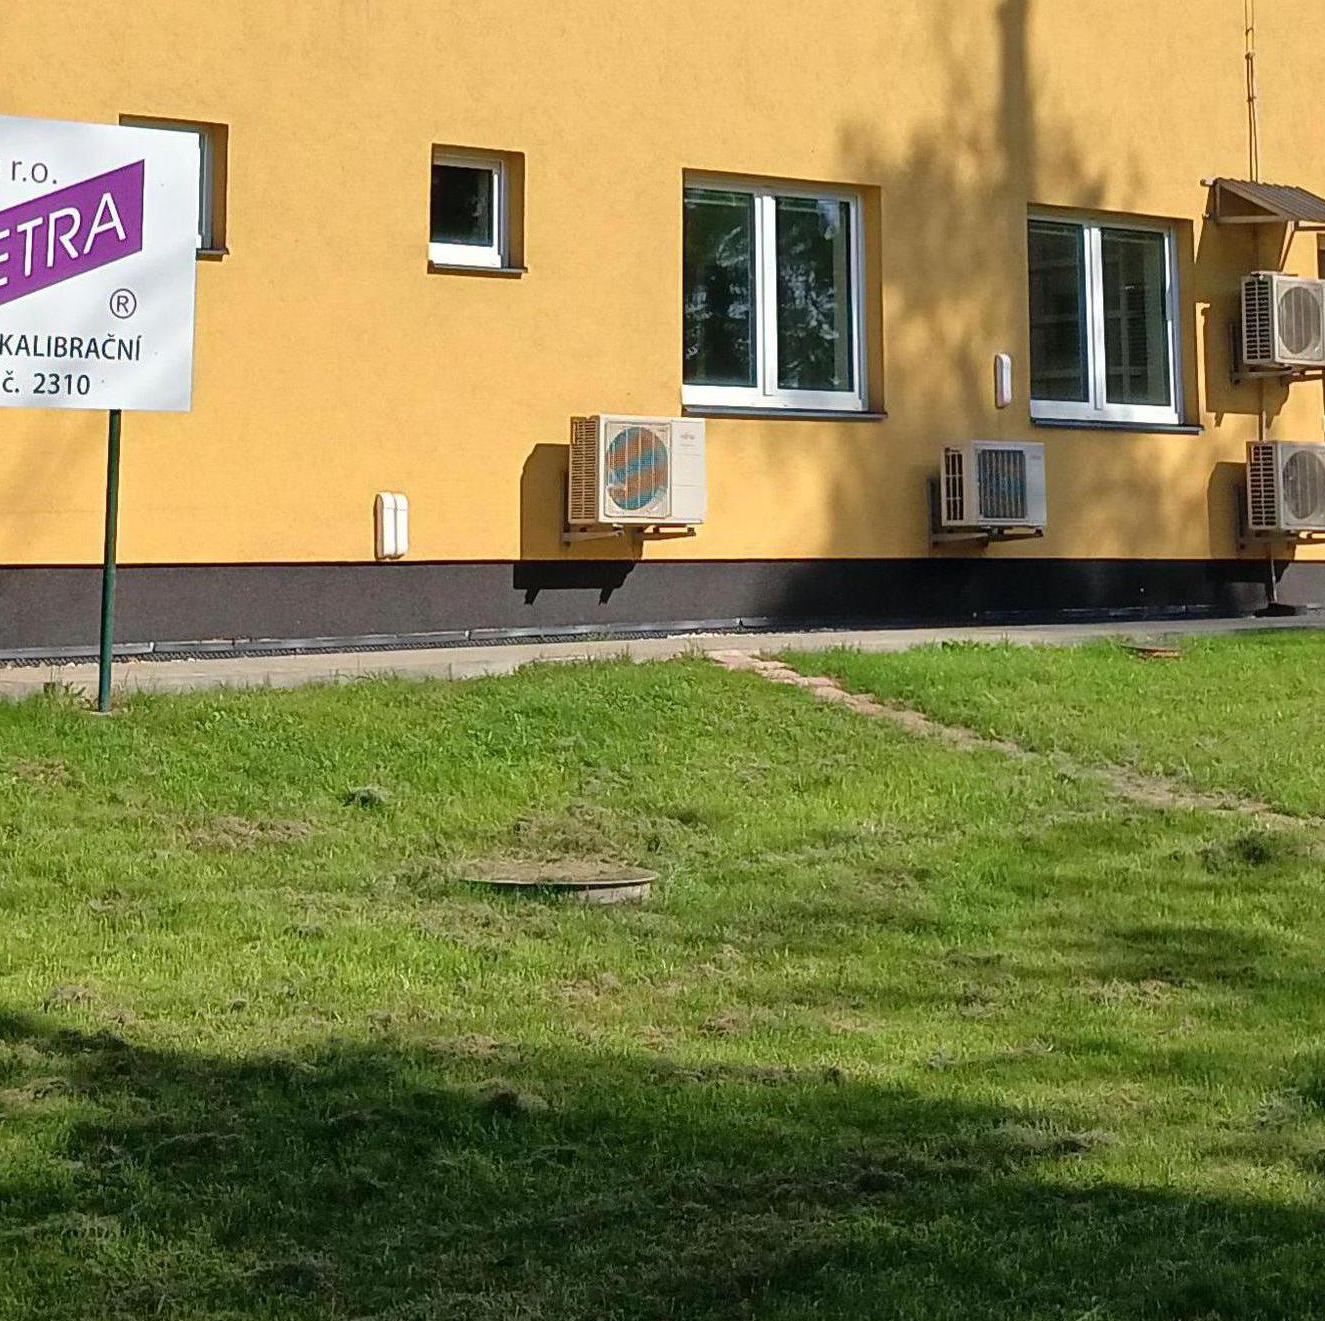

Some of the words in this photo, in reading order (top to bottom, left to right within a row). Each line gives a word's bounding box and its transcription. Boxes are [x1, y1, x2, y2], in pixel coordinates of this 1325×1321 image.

[11, 160, 58, 185] r.o.
[2, 370, 21, 394] č.
[33, 372, 91, 397] 2310
